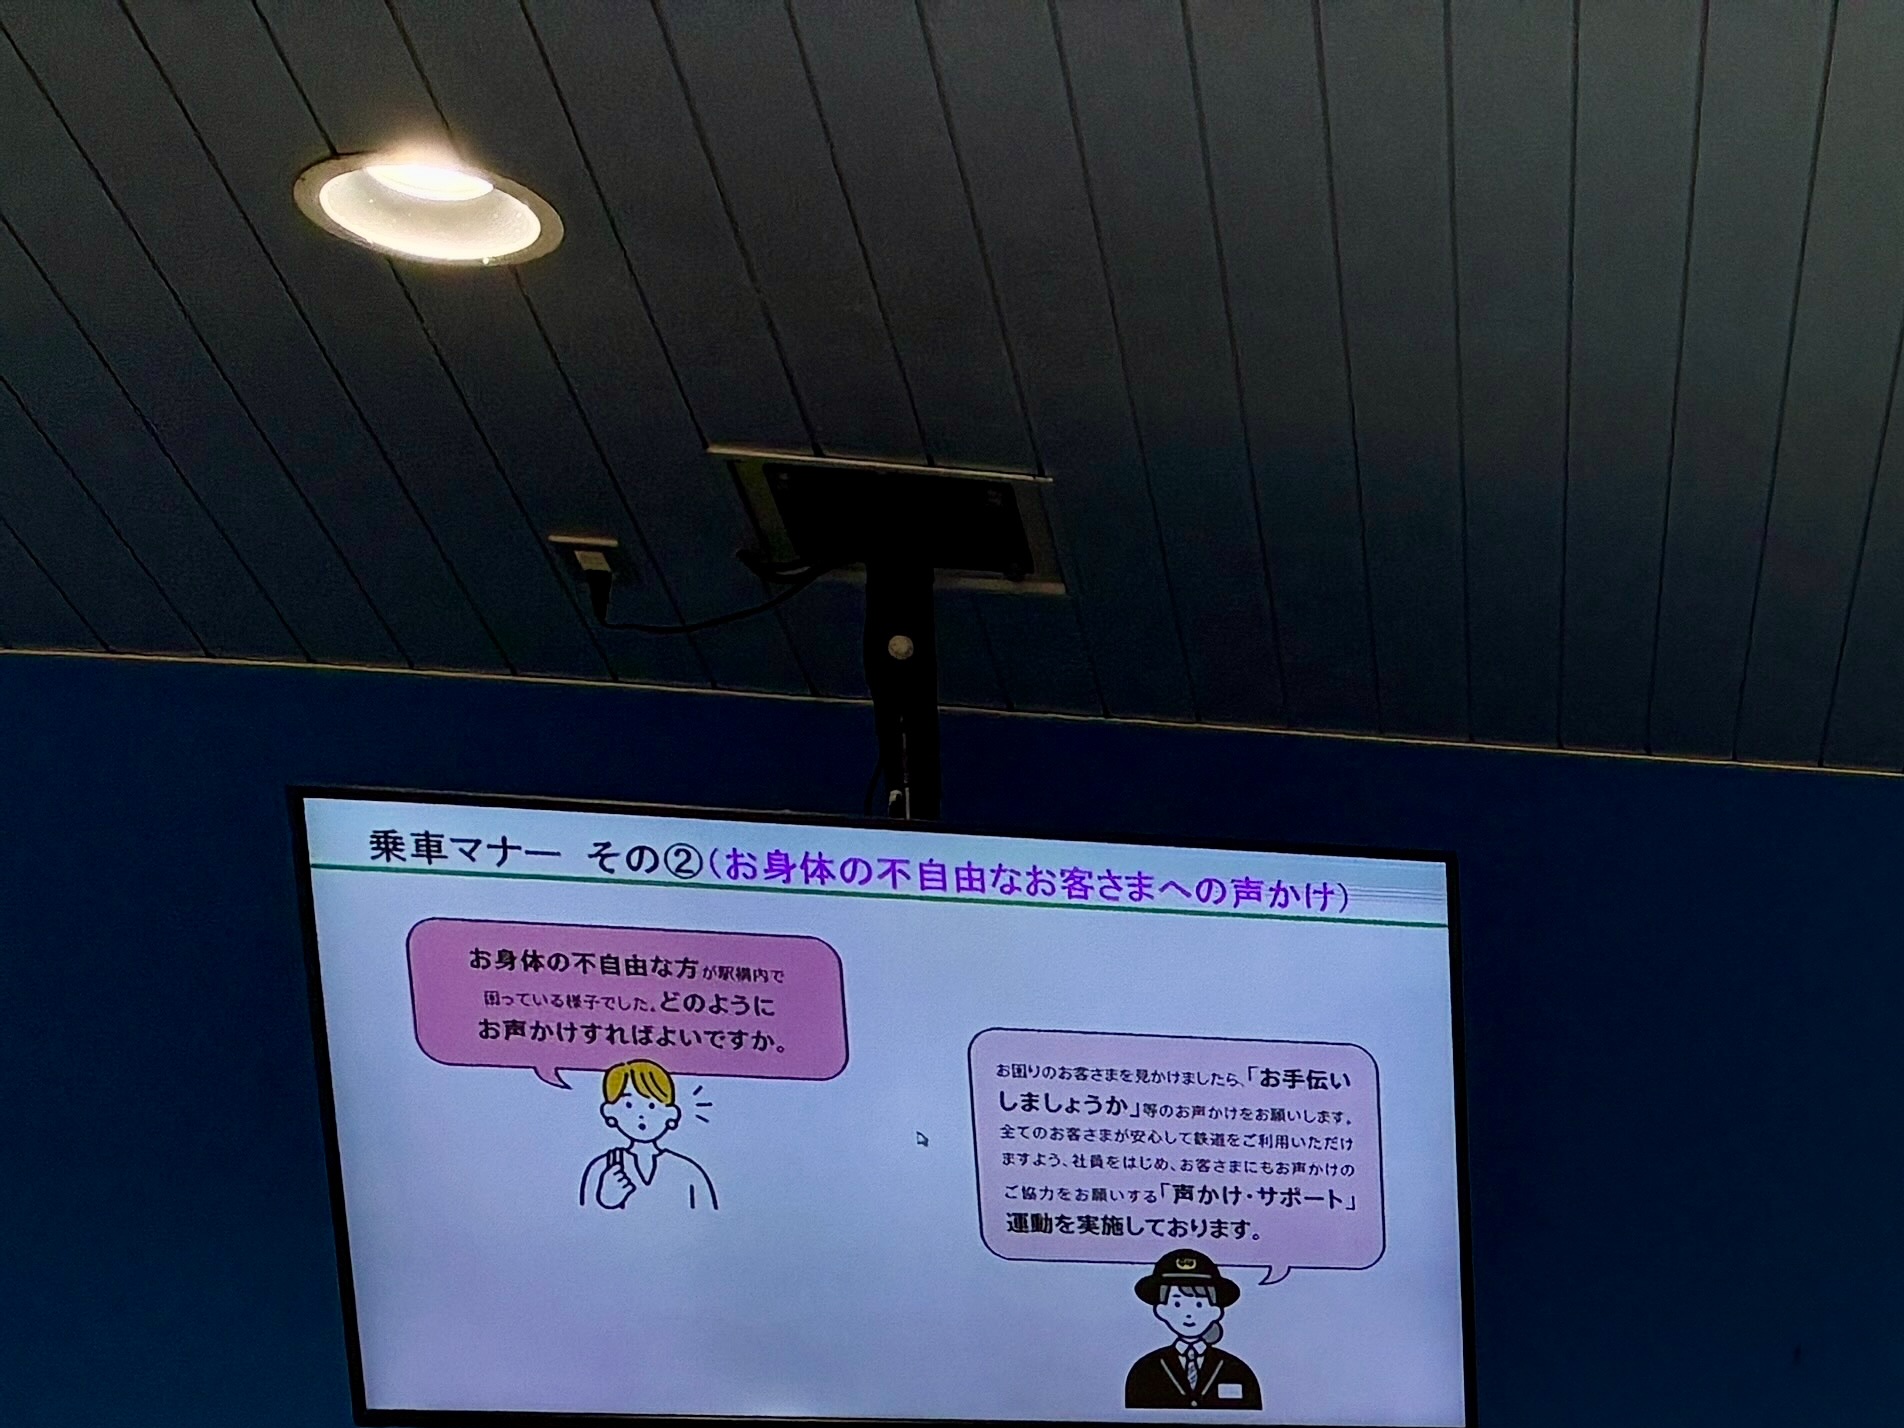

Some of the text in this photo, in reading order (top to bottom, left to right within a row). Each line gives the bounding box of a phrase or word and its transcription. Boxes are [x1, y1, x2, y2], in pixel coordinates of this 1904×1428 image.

[368, 829, 563, 867] 乗車マナー
[477, 1018, 786, 1055] お声かけすればよいですか。
[1006, 1211, 1263, 1243] 運動を実施しております。
